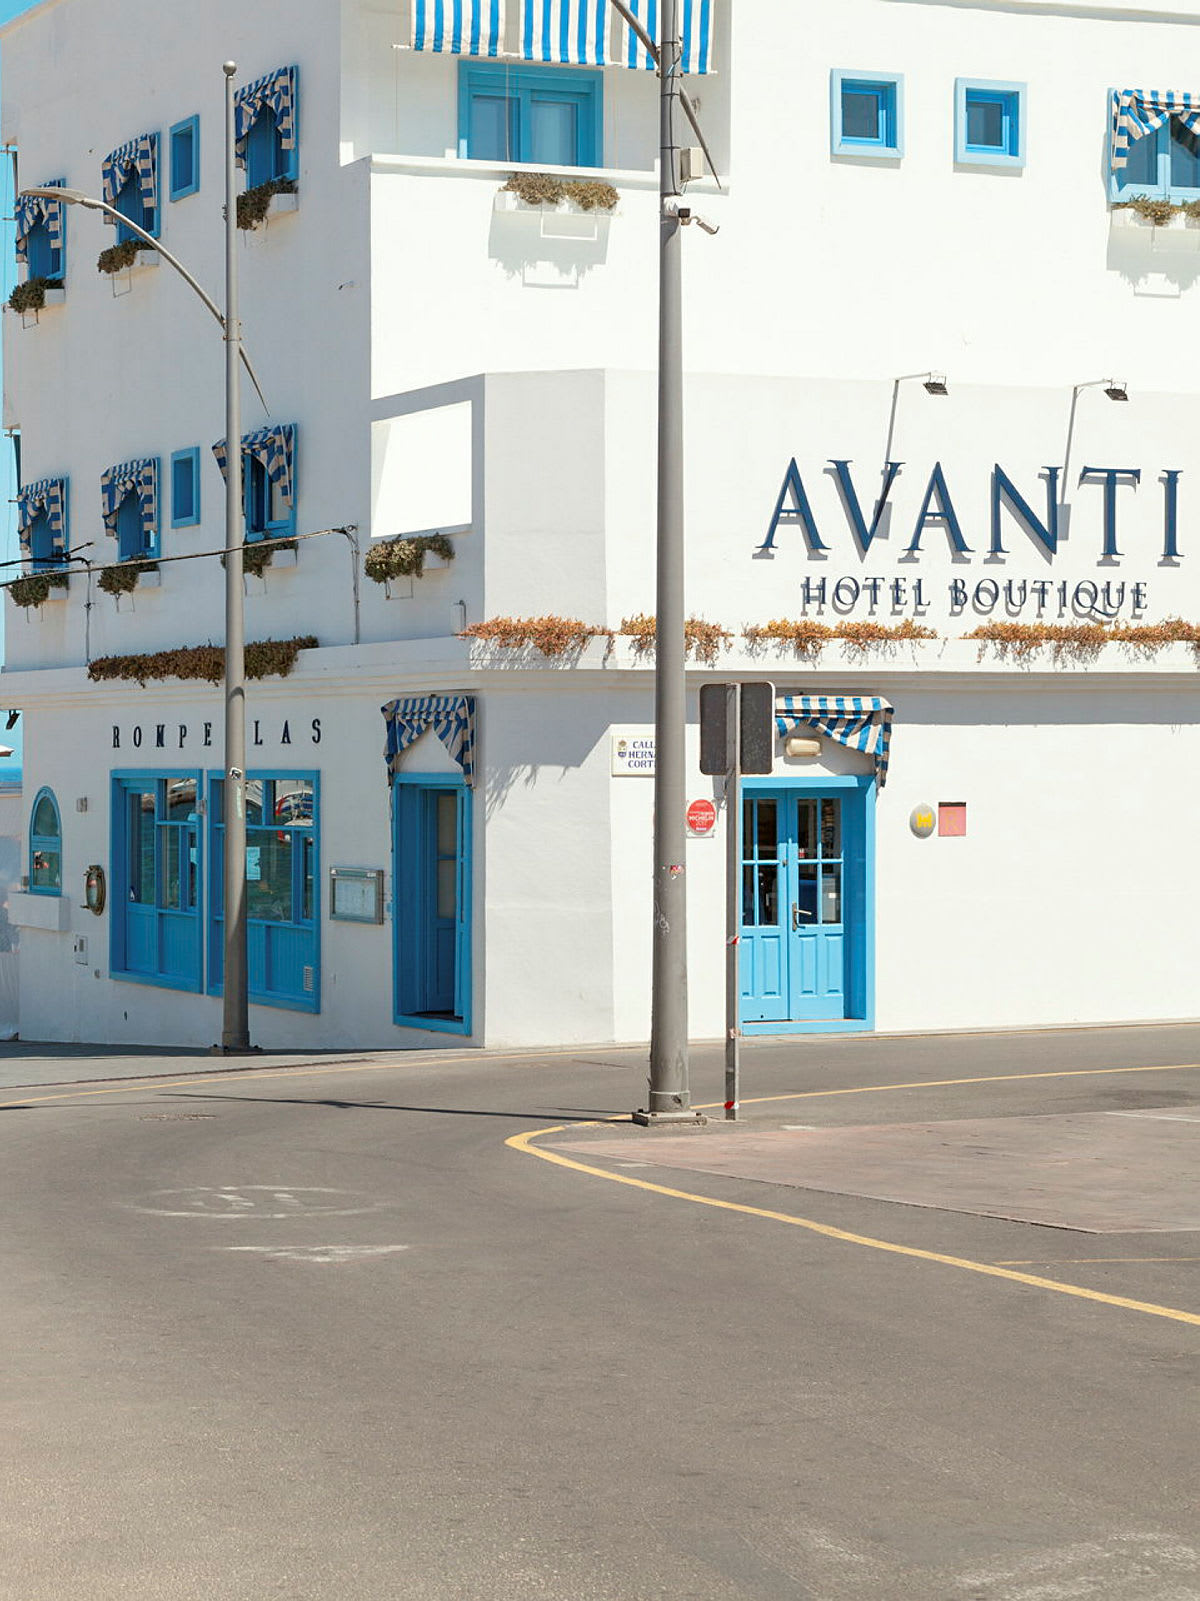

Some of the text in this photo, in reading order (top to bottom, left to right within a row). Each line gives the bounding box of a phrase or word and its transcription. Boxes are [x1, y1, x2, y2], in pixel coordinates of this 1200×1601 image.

[755, 457, 1184, 557] AVANTI
[803, 576, 1148, 617] HOTEL BOUTIQUE
[112, 718, 322, 749] ROMPELAS
[632, 740, 654, 749] CALL
[628, 760, 655, 768] CORT
